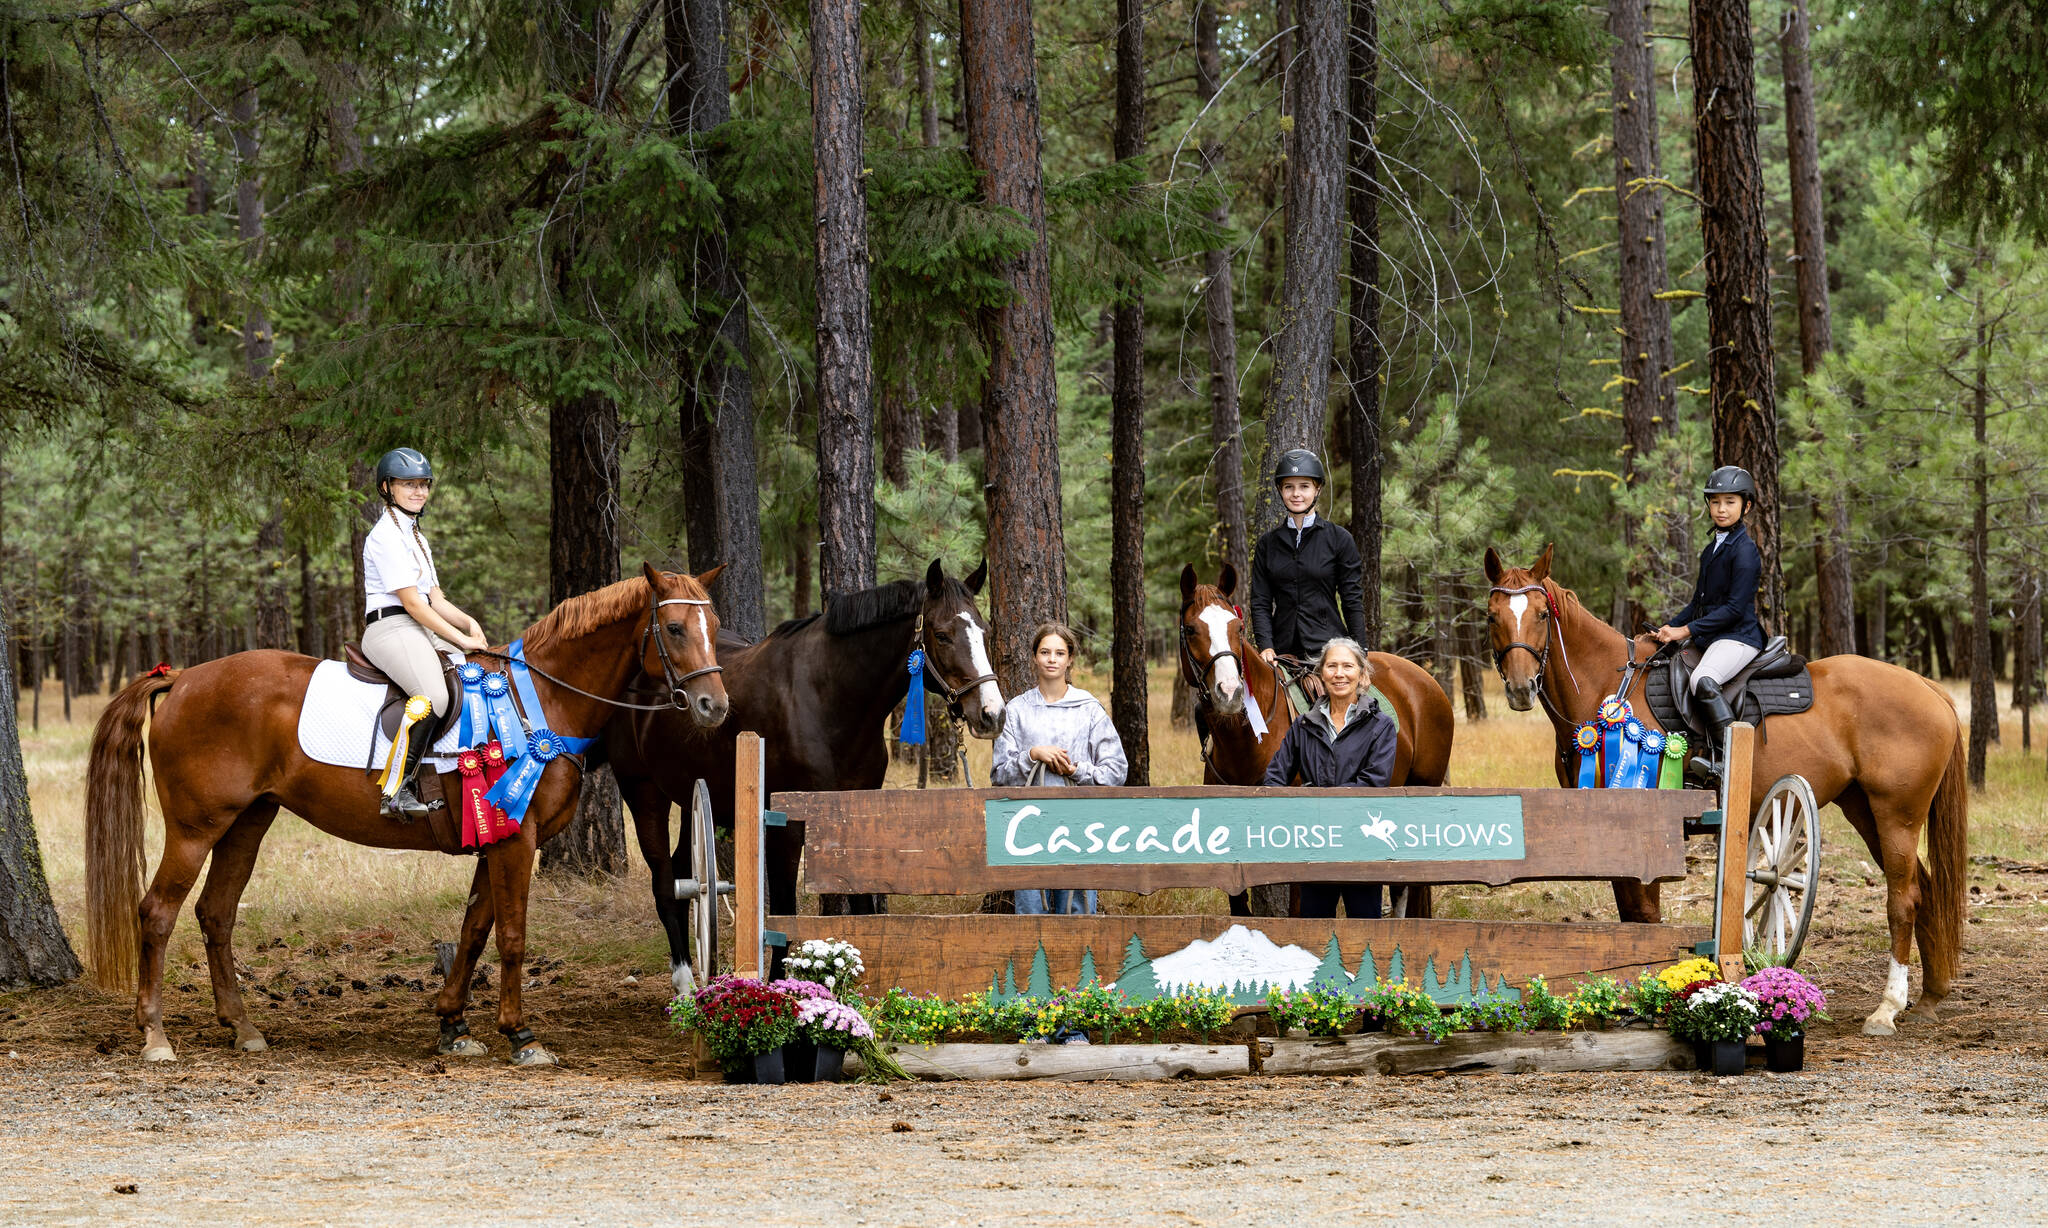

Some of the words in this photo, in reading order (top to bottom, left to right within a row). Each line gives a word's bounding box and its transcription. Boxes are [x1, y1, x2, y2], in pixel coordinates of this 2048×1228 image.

[514, 760, 535, 788] Cascade
[472, 788, 484, 819] Cascade
[1005, 805, 1230, 856] Cascade
[1247, 825, 1343, 848] HORSE
[1405, 824, 1512, 847] SHOWS
